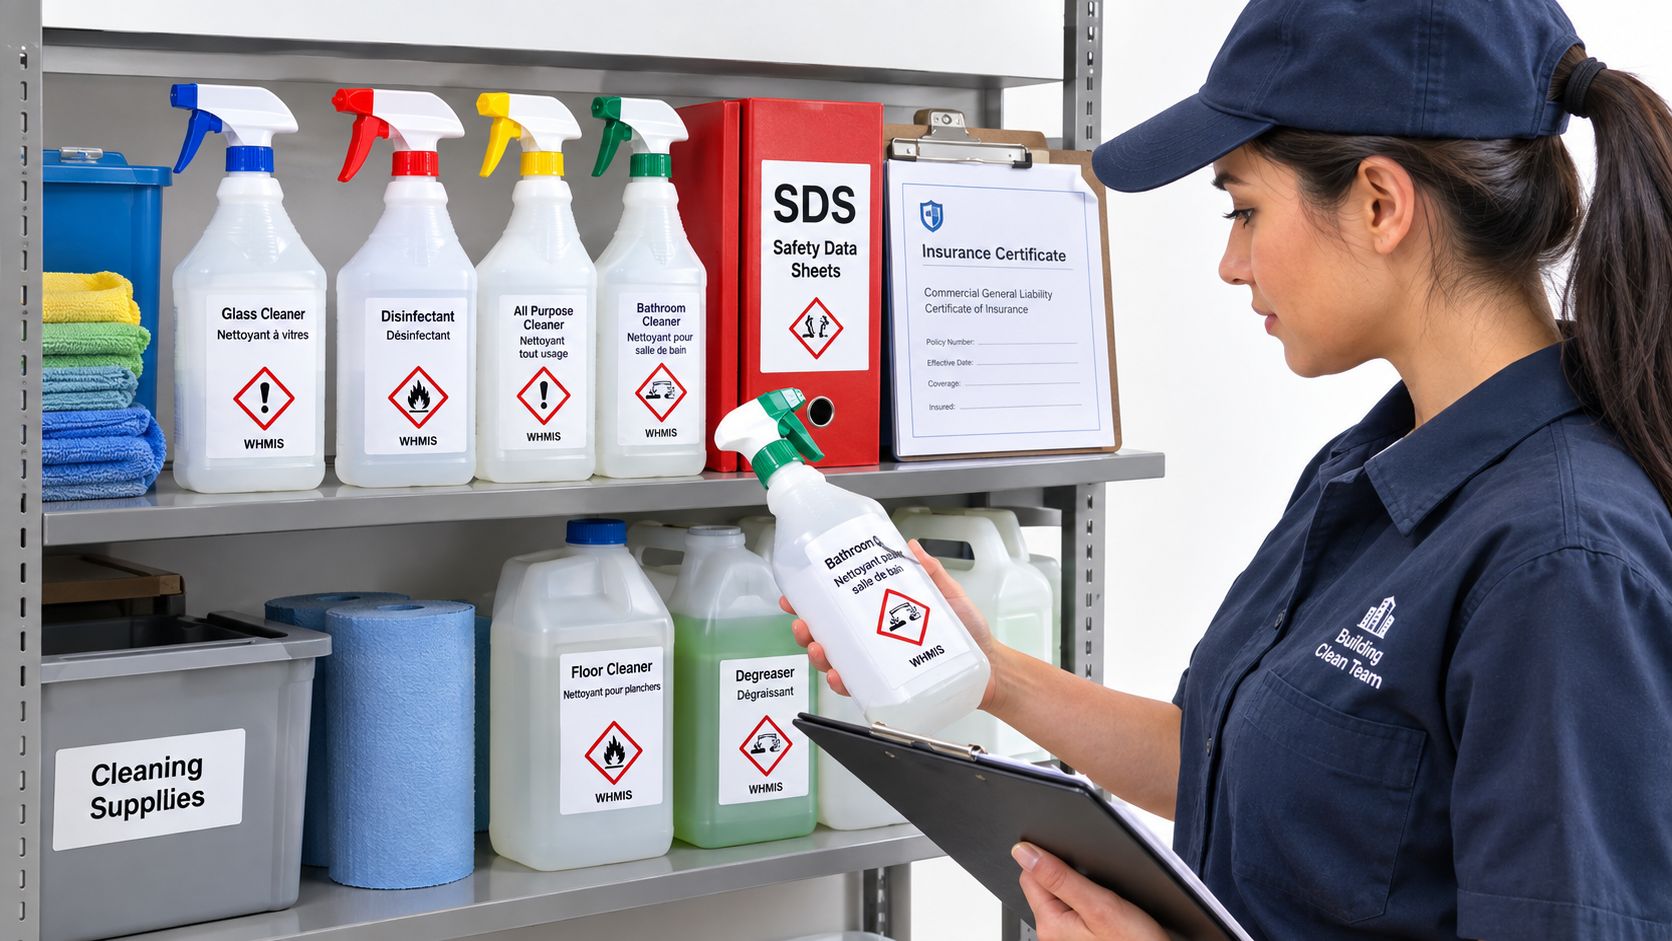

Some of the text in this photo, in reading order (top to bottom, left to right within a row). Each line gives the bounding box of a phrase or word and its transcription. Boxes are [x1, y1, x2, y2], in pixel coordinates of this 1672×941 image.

[774, 183, 856, 224] SDS
[773, 240, 858, 259] Safety Data
[922, 244, 1066, 262] Insurance Certificate
[791, 262, 841, 278] Sheets
[924, 288, 1053, 301] Commercial General Liability
[221, 307, 305, 321] Glass Cleaner
[514, 305, 573, 319] All Purpose
[637, 302, 686, 314] Bathroom
[925, 303, 1028, 314] Certificate of Insurance
[381, 310, 455, 323] Disinfectant
[642, 315, 681, 327] Cleaner
[523, 318, 565, 331] Cleaner
[217, 329, 271, 342] Nettoyant
[281, 329, 309, 341] vitres
[386, 329, 451, 341] Désinfectant
[520, 336, 565, 347] Nettoyant
[627, 332, 693, 344] Nettoyant pour
[926, 338, 975, 348] Policy Number:
[519, 349, 569, 361] tout usage
[635, 345, 687, 355] salle de bain
[956, 359, 974, 367] Date:
[928, 380, 961, 389] Coverage:
[929, 402, 955, 411] Insured:
[526, 431, 562, 442] WHMIS
[645, 428, 678, 438] WHMIS
[243, 438, 285, 450] WHMIS
[399, 435, 438, 447] WHMIS
[833, 556, 881, 588] Nettoyant
[852, 578, 874, 595] salle
[875, 571, 887, 582] de
[1335, 627, 1384, 666] Building
[909, 644, 945, 668] WHMIS
[571, 661, 653, 679] Floor Cleaner
[1315, 643, 1383, 690] Clean Team
[735, 667, 796, 684] Degreaser
[563, 682, 661, 700] Nettoyant pour planchers
[737, 685, 794, 702] Dégraissant
[91, 755, 203, 787] Cleaning
[749, 781, 784, 795] WHMIS
[595, 789, 633, 804] WHMIS
